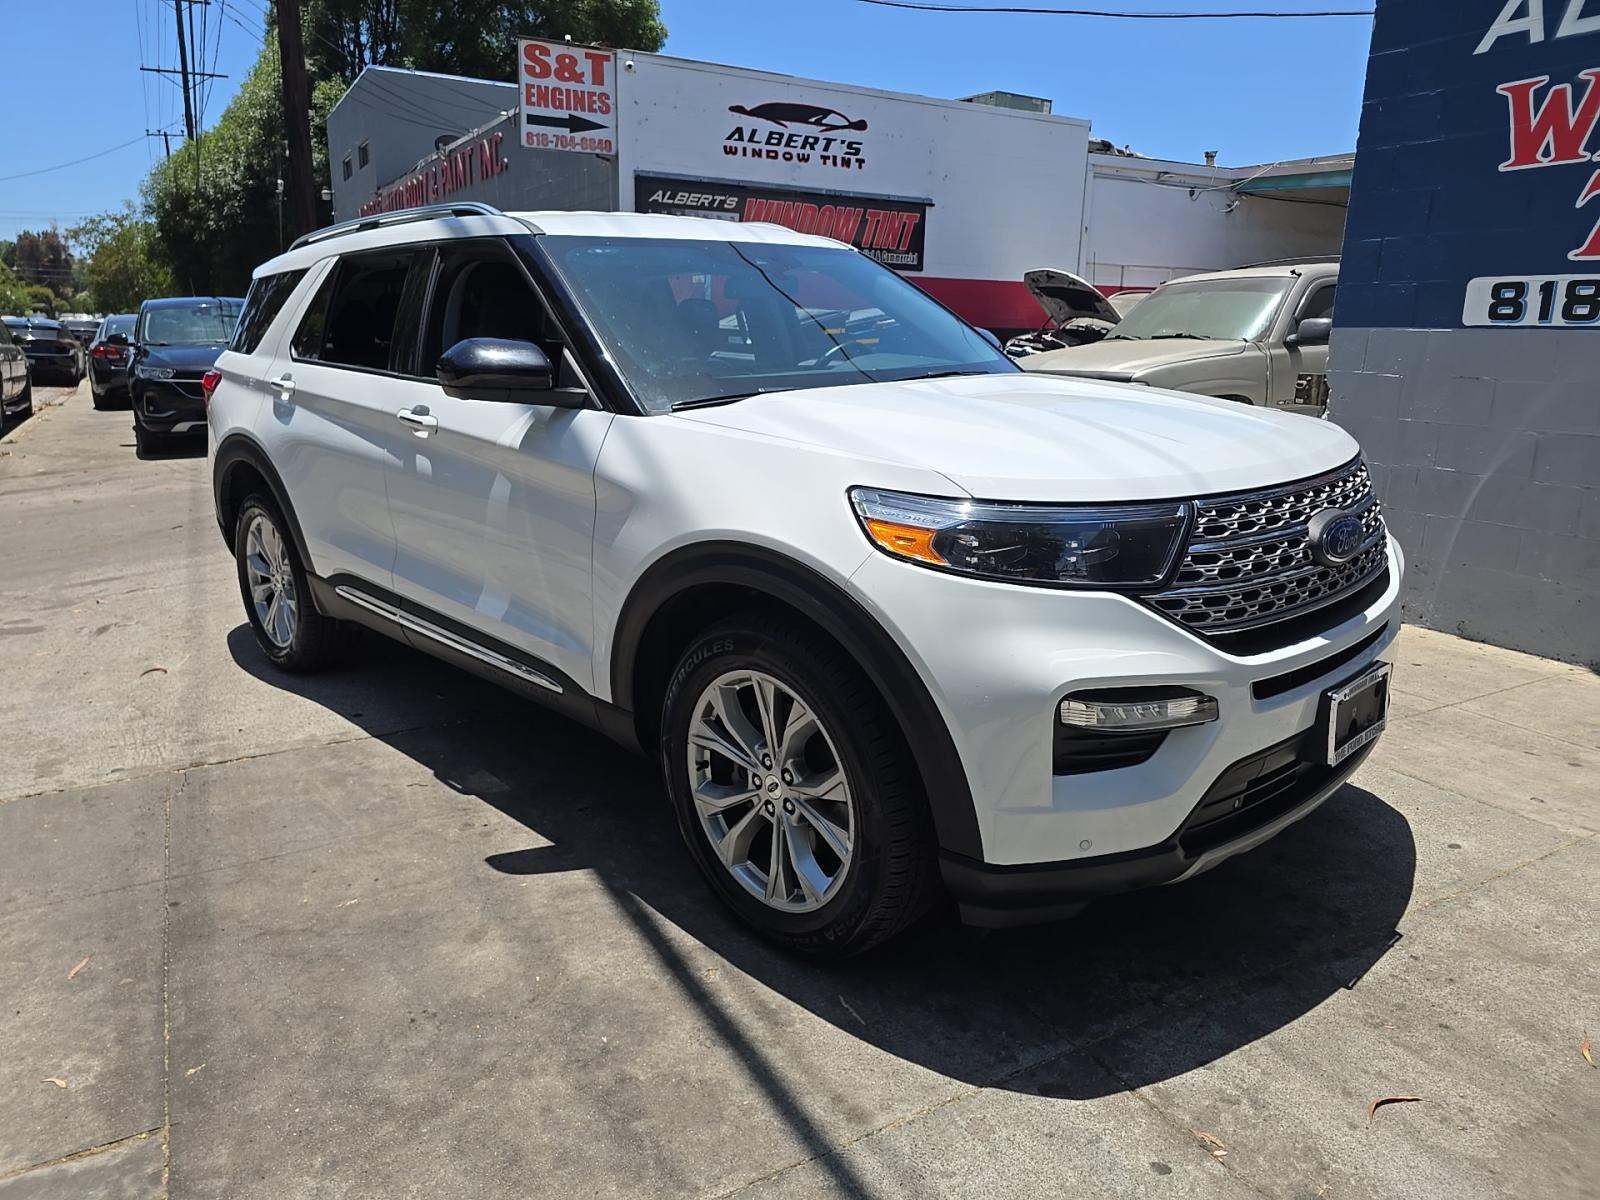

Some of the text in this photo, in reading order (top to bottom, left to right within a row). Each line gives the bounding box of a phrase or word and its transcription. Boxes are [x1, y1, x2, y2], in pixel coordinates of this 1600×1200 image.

[524, 43, 611, 87] S&T
[525, 83, 612, 115] ENGINES
[1496, 68, 1600, 171] W
[723, 144, 866, 170] WINDOW TINT
[724, 126, 864, 157] ALBERT'S
[441, 146, 474, 197] PAINT
[477, 131, 509, 182] INC.
[648, 190, 739, 209] ALBERT'S
[743, 198, 921, 251] WINDOW TINT
[882, 250, 919, 265] Commercial
[1488, 279, 1600, 324] 818
[1337, 527, 1359, 553] Ford
